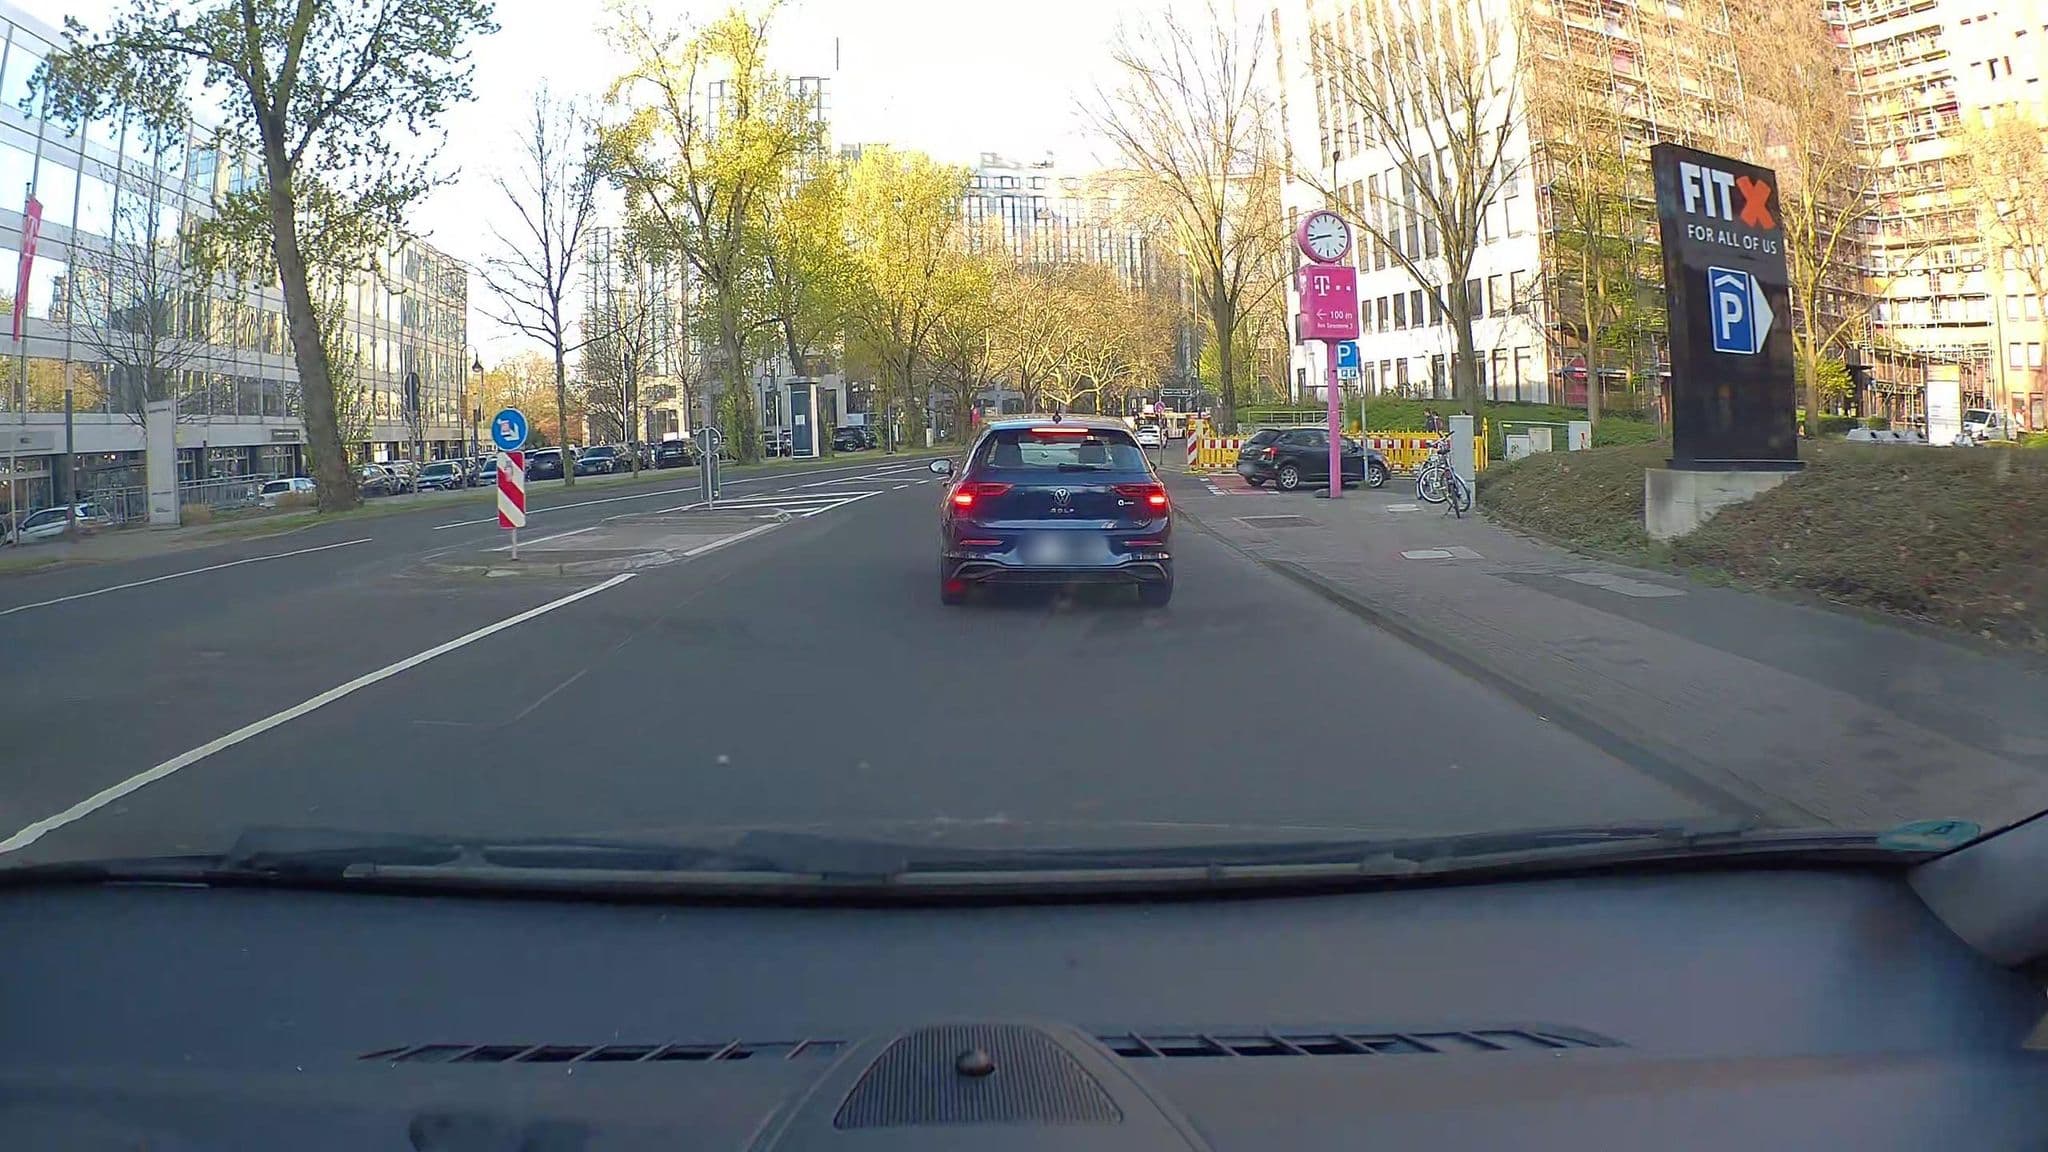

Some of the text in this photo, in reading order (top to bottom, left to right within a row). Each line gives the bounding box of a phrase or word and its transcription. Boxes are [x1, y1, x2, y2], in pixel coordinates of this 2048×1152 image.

[1679, 161, 1776, 230] FITX
[1687, 224, 1777, 255] FOR ALL OF US
[1330, 310, 1353, 320] 100 m
[1719, 291, 1743, 340] P
[1338, 344, 1351, 365] P
